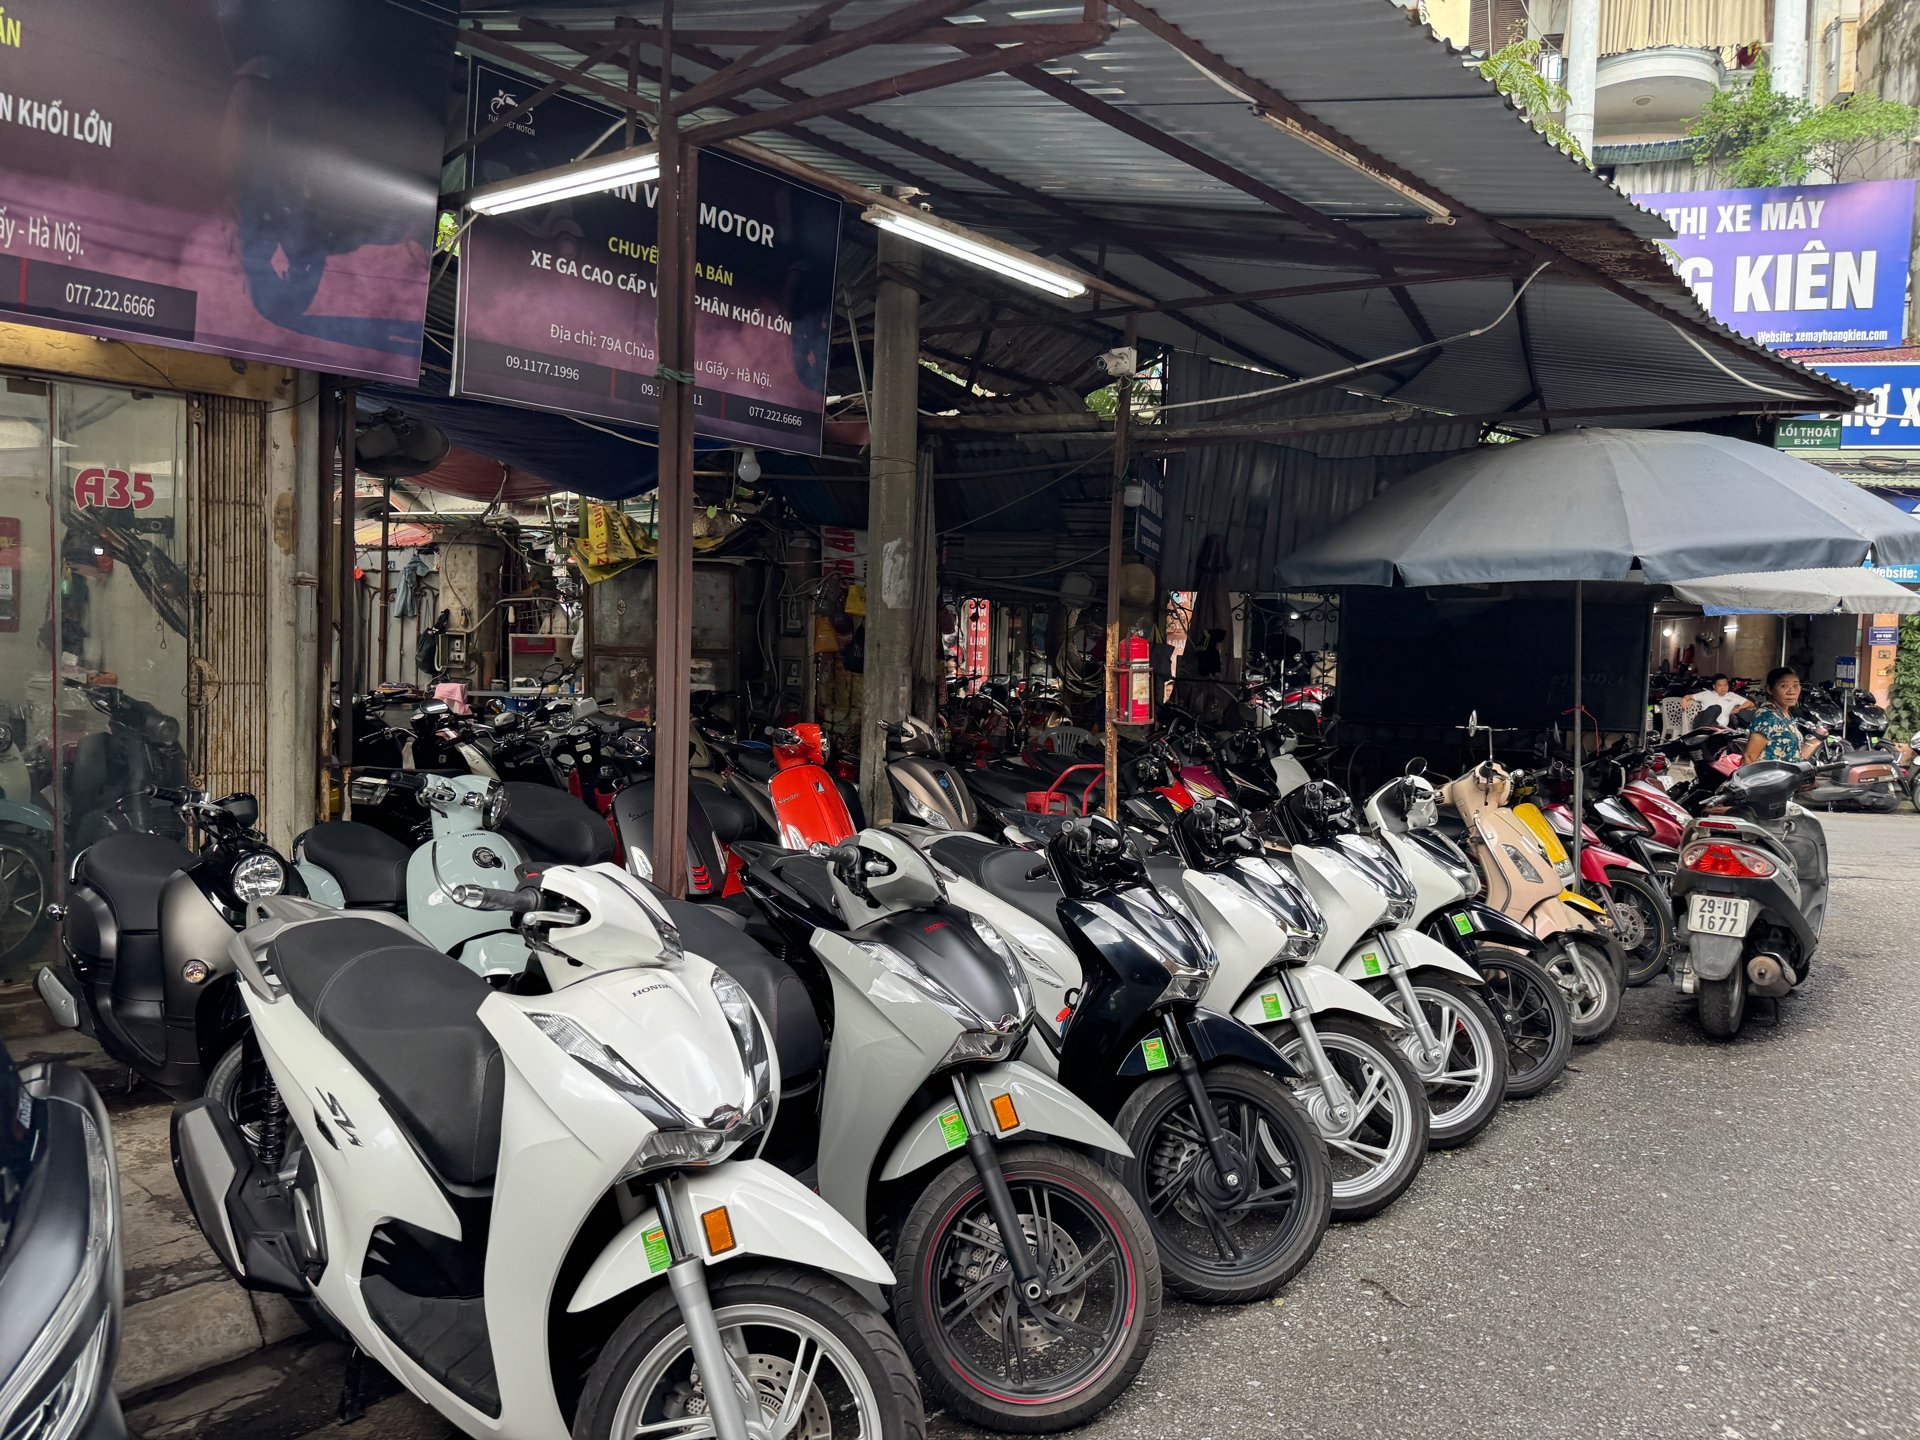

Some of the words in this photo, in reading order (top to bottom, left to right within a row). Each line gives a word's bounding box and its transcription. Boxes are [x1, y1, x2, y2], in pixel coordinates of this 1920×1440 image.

[18, 97, 69, 136] KHỐI
[73, 109, 112, 148] LỚN
[516, 122, 536, 137] MOTOR
[700, 201, 775, 248] MOTOR
[1715, 203, 1752, 235] XE
[1760, 195, 1826, 233] MÁY
[28, 215, 50, 249] Hà
[53, 221, 84, 261] Nội.
[608, 236, 659, 265] CHUYÊ
[706, 264, 734, 287] BÁN
[1733, 239, 1878, 313] KIÊN
[65, 282, 156, 318] 077.222.6666
[530, 249, 552, 271] XE
[555, 257, 578, 277] GA
[581, 264, 614, 286] CAO
[617, 273, 647, 294] CẤP
[732, 305, 765, 328] KHỐI
[767, 314, 793, 336] LỚN
[550, 323, 571, 344] Địa
[574, 329, 597, 348] chỉ:
[600, 335, 622, 353] 79A
[624, 341, 655, 361] Chùa
[705, 360, 729, 380] Giấy
[736, 367, 751, 383] Hà
[753, 371, 773, 390] Nội.
[1757, 330, 1794, 344] Website:
[1794, 328, 1888, 344] xemayhoangkien.com
[505, 354, 581, 382] 09.1177.1996
[748, 405, 803, 428] 077.222.6666
[1778, 423, 1798, 438] LỐI
[1800, 424, 1839, 438] THOÁT
[1793, 438, 1823, 446] EXIT
[74, 465, 155, 511] A35
[1698, 898, 1739, 918] 29-U1
[1698, 914, 1738, 933] 1677
[631, 983, 672, 998] HONDA
